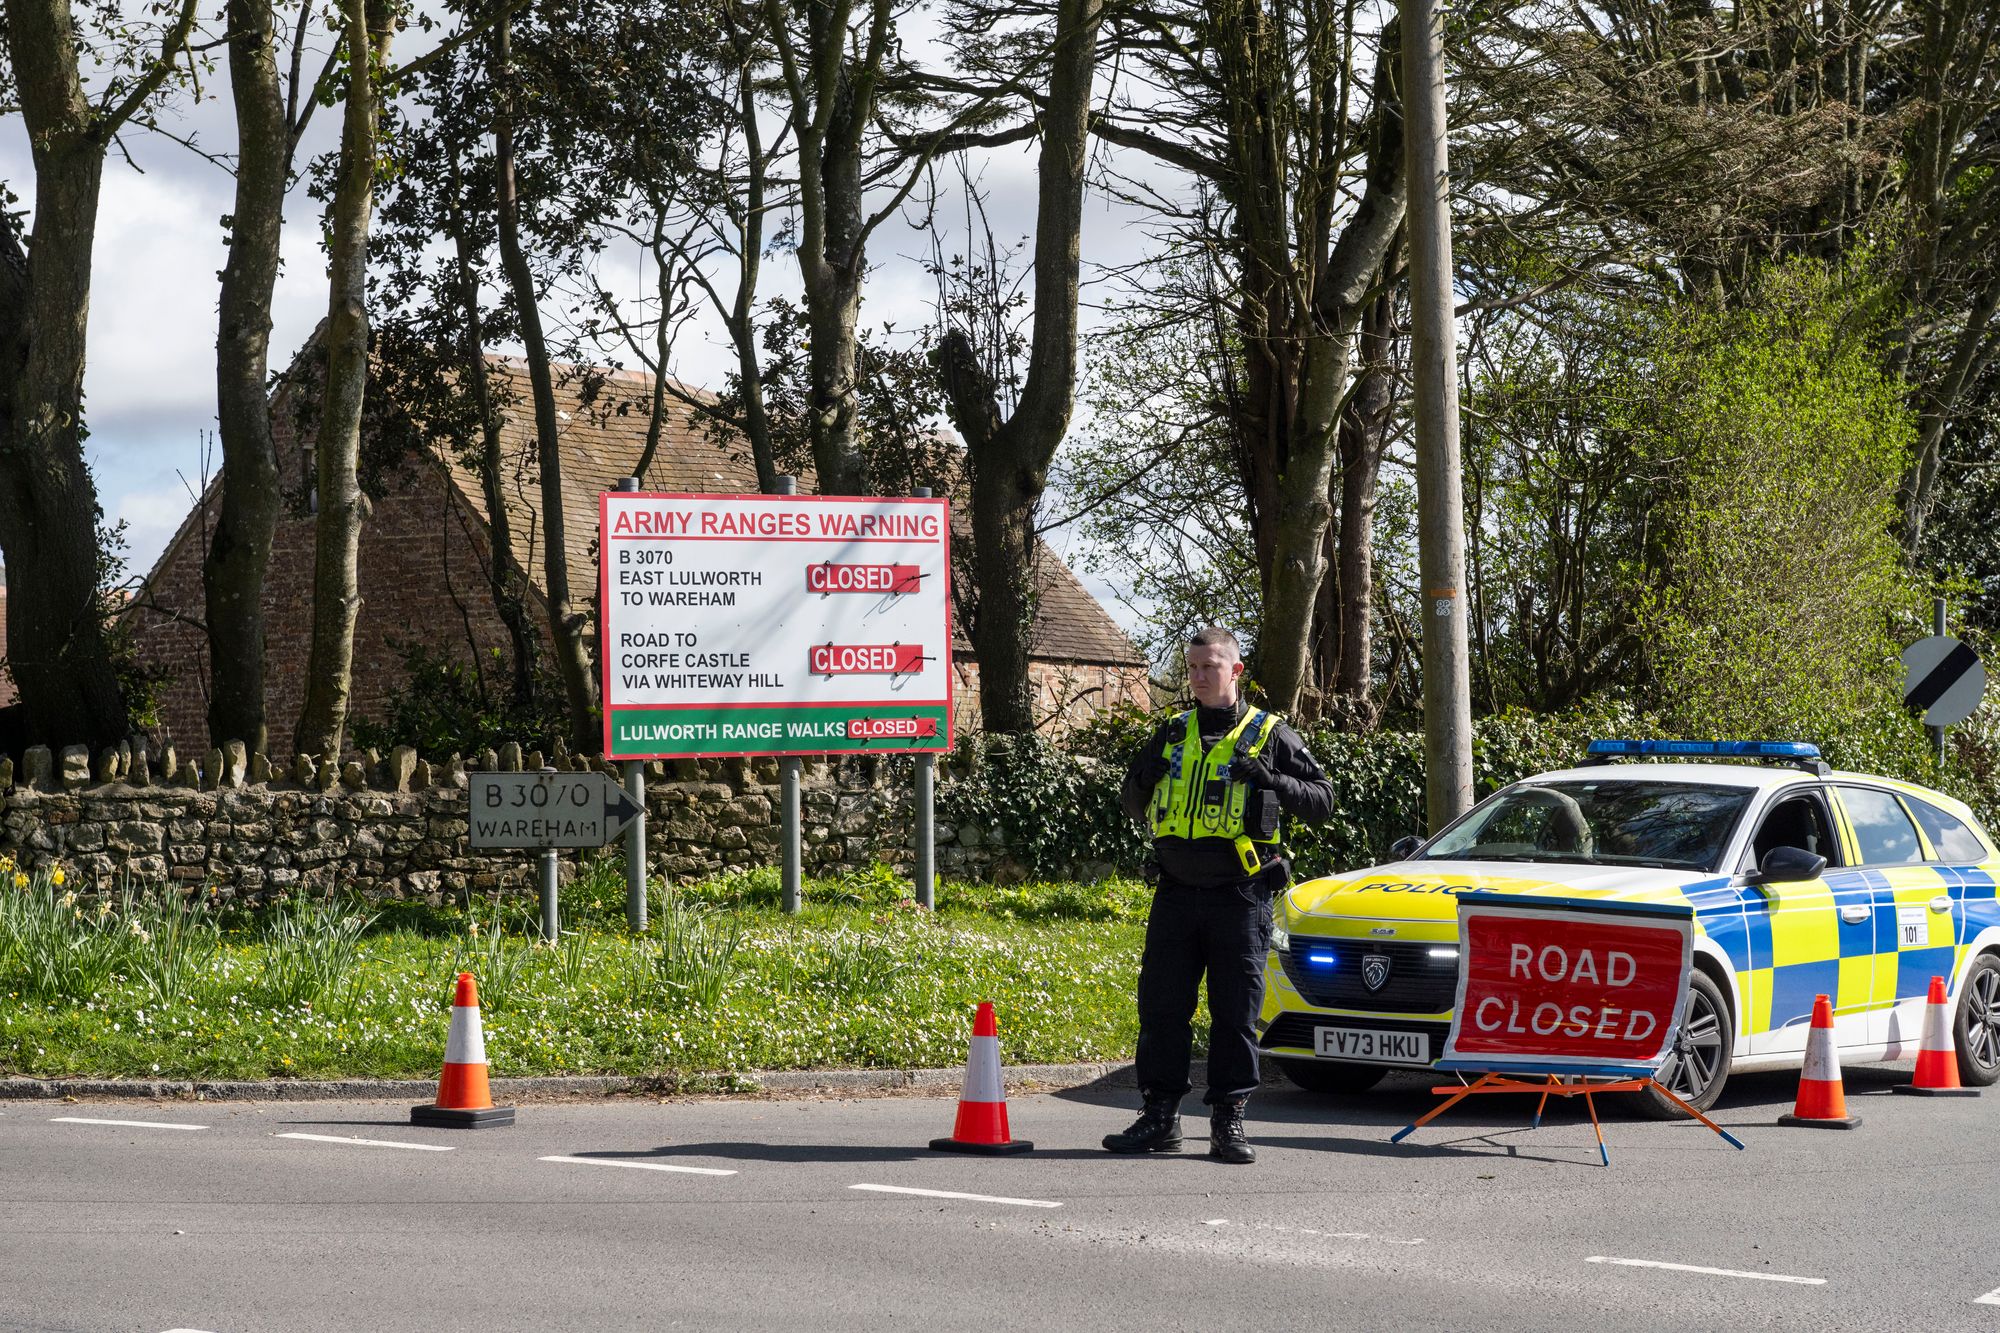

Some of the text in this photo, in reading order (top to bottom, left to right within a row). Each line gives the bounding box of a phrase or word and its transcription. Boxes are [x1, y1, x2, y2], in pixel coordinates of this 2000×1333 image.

[613, 511, 939, 537] ARMY RANGES WARNING
[619, 550, 673, 565] B 3070
[619, 570, 762, 586] EAST LULWORTH
[811, 566, 894, 590] CLOSED
[620, 591, 736, 606] TO WAREHAM
[620, 633, 697, 648] ROAD TO
[621, 653, 750, 669] CORFE CASTLE
[814, 647, 897, 671] CLOSED
[622, 673, 784, 689] VIA WHITEWAY HILL
[620, 720, 918, 741] LULWORTH RANGE WALKS CLOSED
[486, 783, 503, 808] B
[476, 819, 597, 838] WAREHAM
[1904, 926, 1918, 943] 101
[1509, 943, 1637, 987] ROAD
[1475, 996, 1657, 1041] CLOSED
[1323, 1030, 1419, 1058] FV73 HKU
